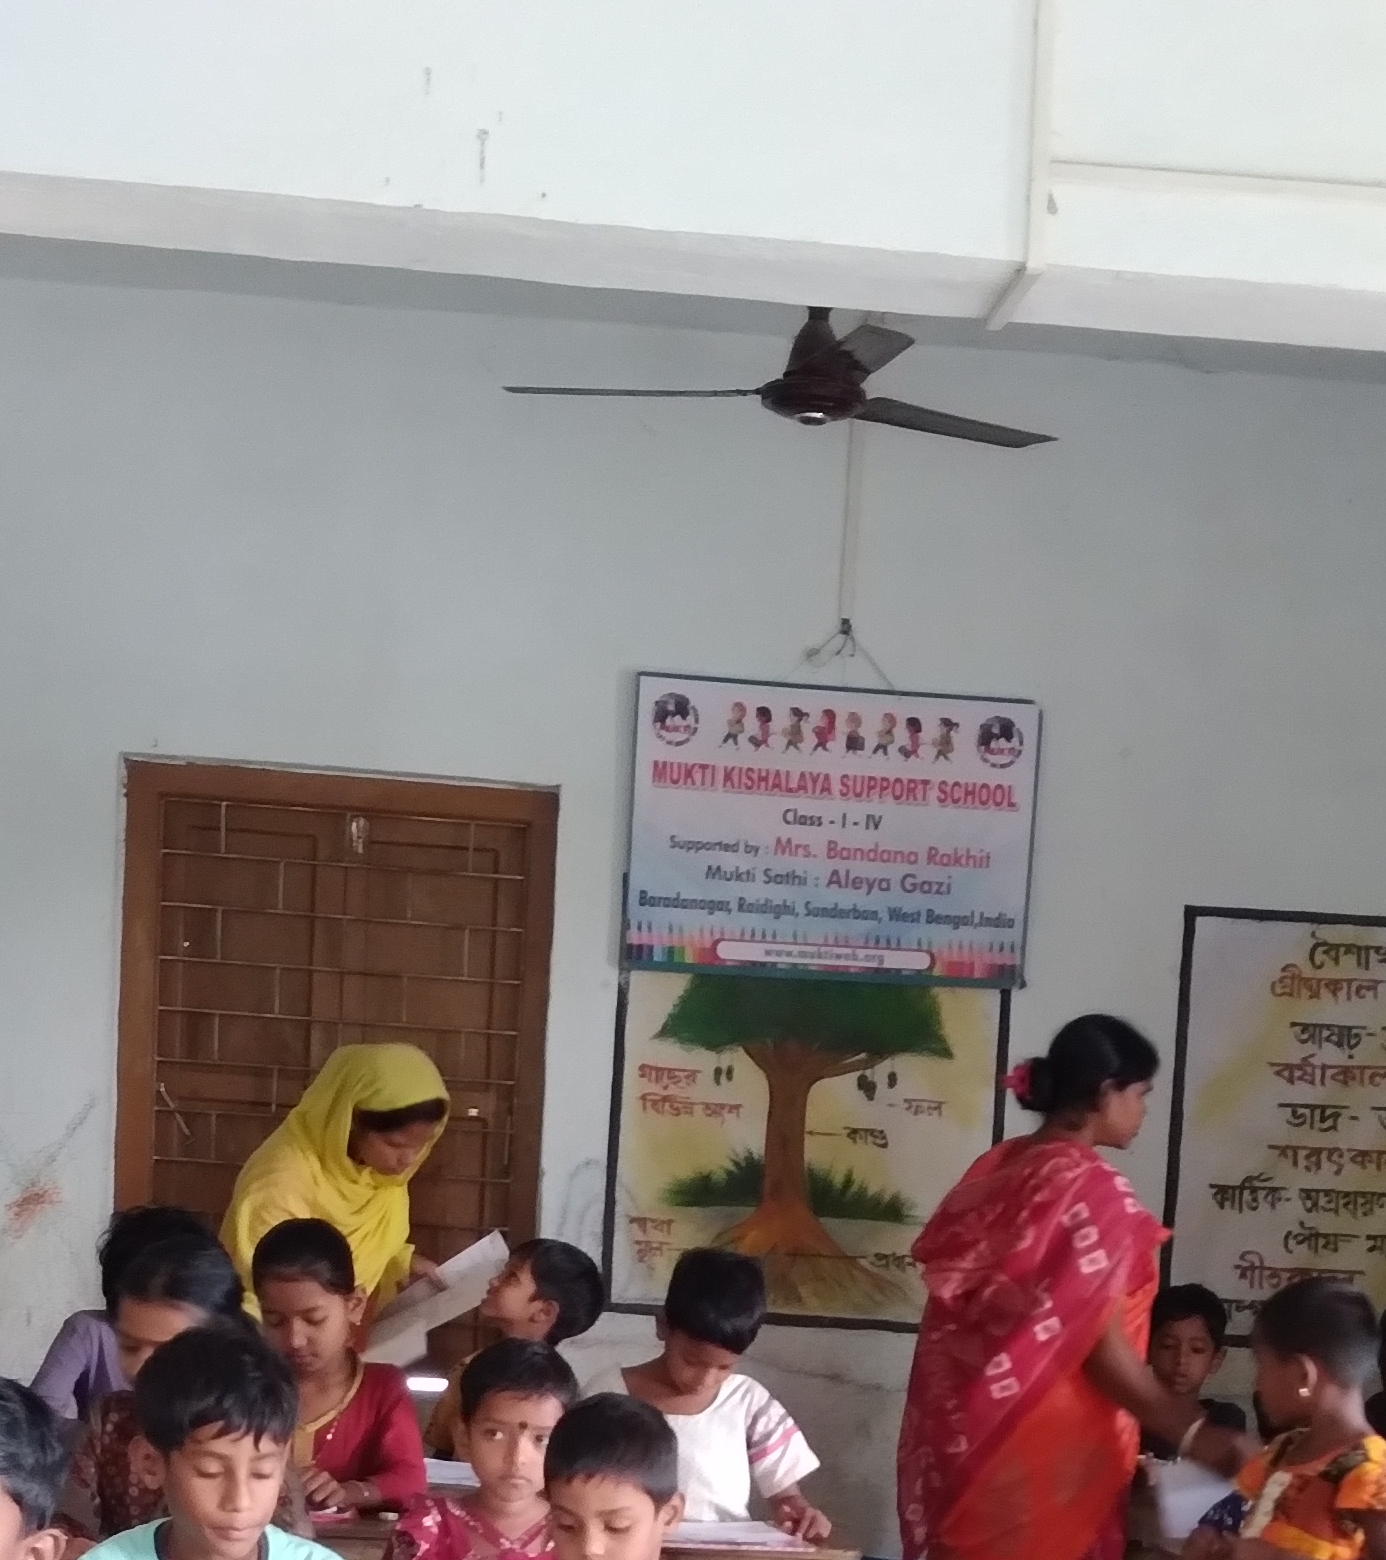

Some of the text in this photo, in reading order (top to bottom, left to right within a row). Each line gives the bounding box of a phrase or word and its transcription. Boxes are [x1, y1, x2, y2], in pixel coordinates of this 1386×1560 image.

[652, 760, 1018, 808] MUKTI KISHALAYA SUPPORT SCHOOL
[782, 808, 823, 827] Class
[865, 814, 883, 831] IV
[669, 834, 739, 853] Supported
[773, 837, 817, 858] Mrs.
[826, 840, 918, 865] Bandana
[926, 846, 991, 869] Rakhit
[705, 865, 756, 883] Mukti
[826, 869, 891, 895] Aleya
[900, 873, 952, 895] Gazi
[888, 906, 921, 923] West
